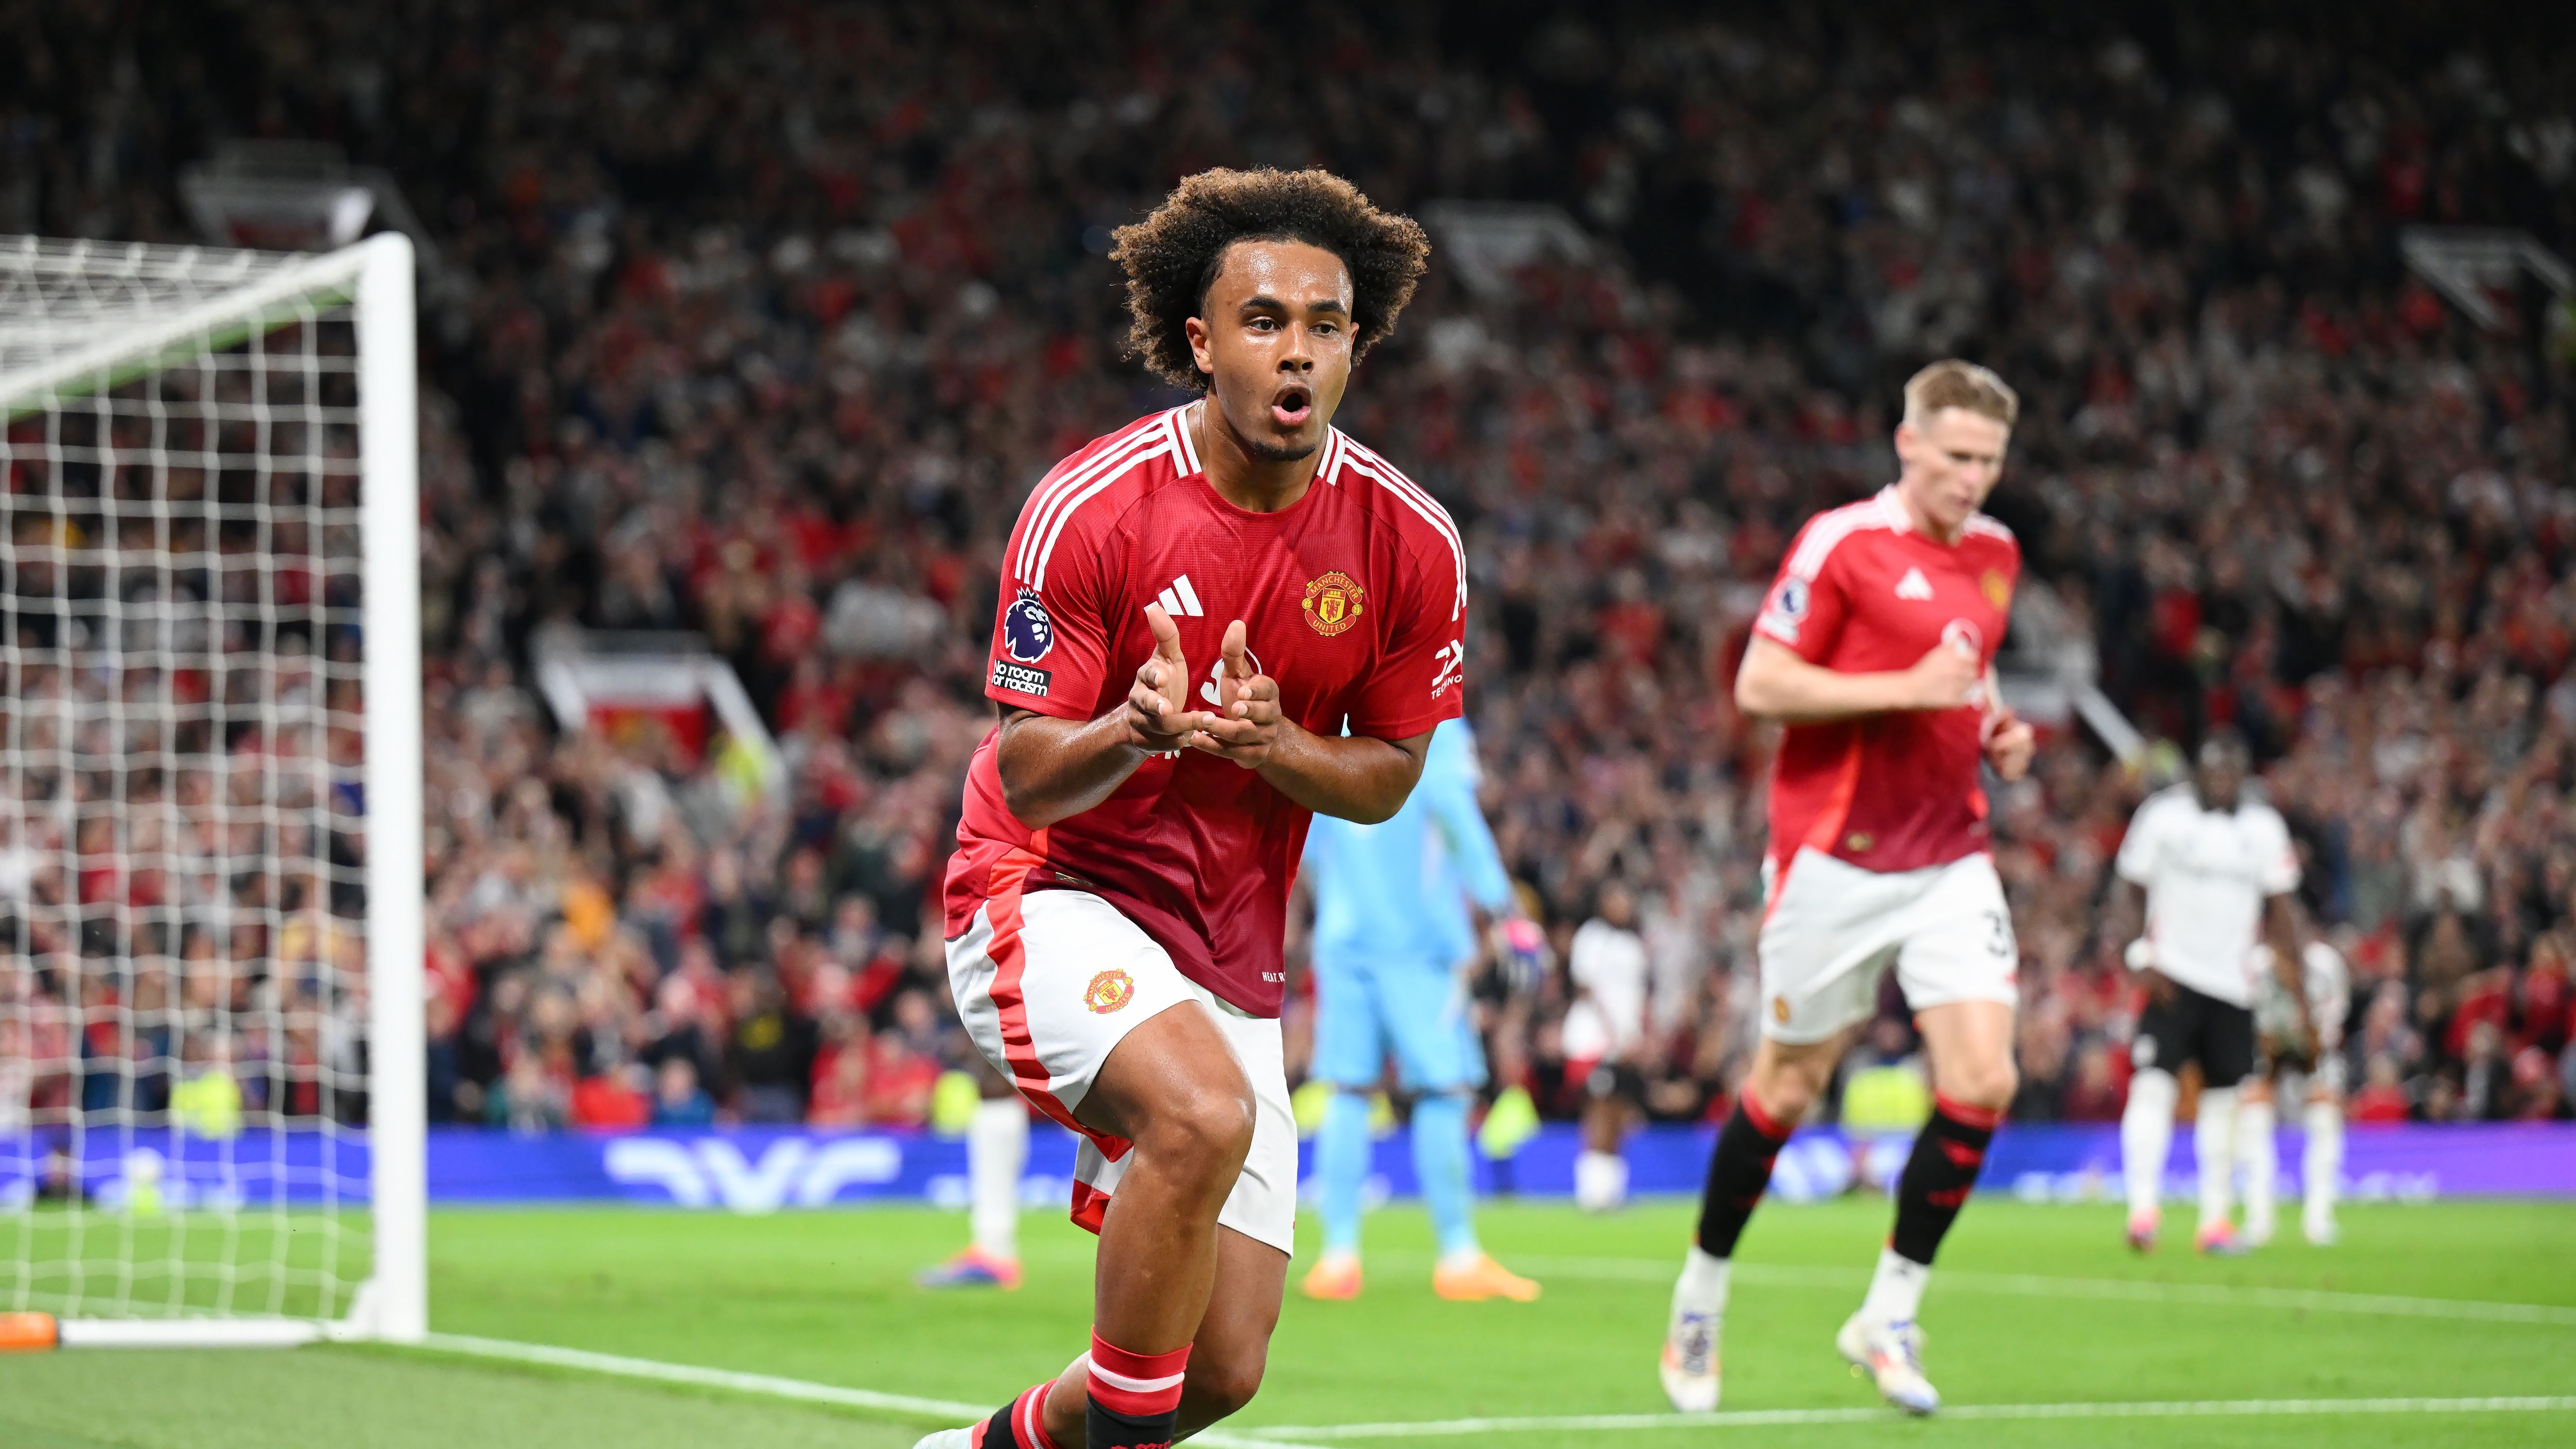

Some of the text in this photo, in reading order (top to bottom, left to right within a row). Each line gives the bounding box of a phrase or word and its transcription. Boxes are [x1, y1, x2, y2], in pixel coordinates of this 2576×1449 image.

[1310, 576, 1358, 600] MANCHESTER
[1313, 619, 1346, 632] UNITED
[1008, 666, 1044, 684] room
[1004, 677, 1048, 697] racism
[1088, 972, 1121, 1000] MANCHESTER
[1262, 971, 1286, 983] HEAT.R
[1106, 992, 1130, 1012] UNITED
